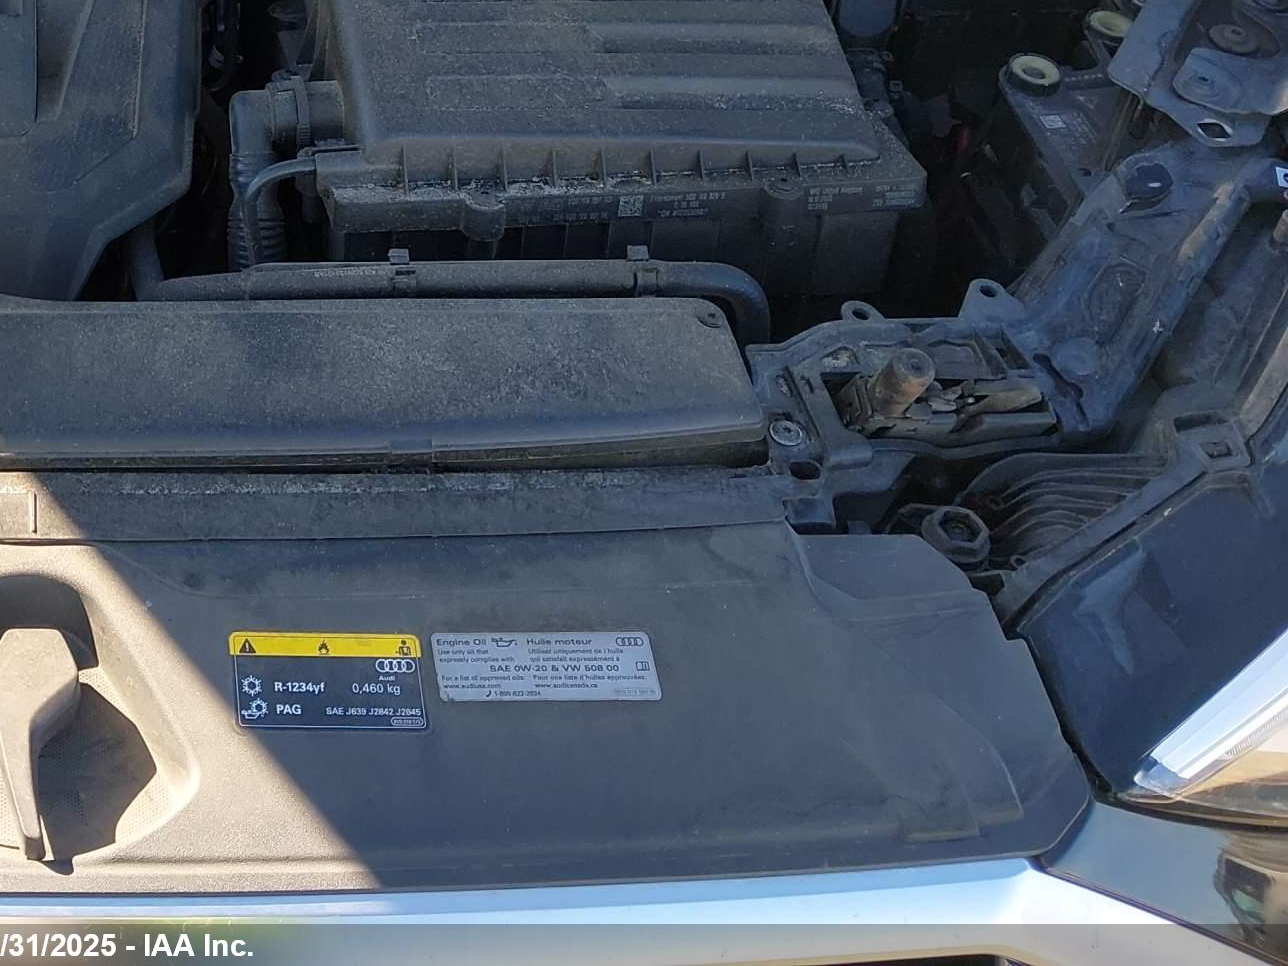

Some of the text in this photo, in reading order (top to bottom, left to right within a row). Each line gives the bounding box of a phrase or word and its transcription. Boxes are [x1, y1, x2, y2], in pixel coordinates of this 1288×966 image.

[436, 638, 470, 647] Engine
[562, 664, 582, 672] VW
[274, 681, 401, 696] R-1234yf 0,460 kg
[276, 704, 422, 716] PAG SAE J639 J2842 J2845
